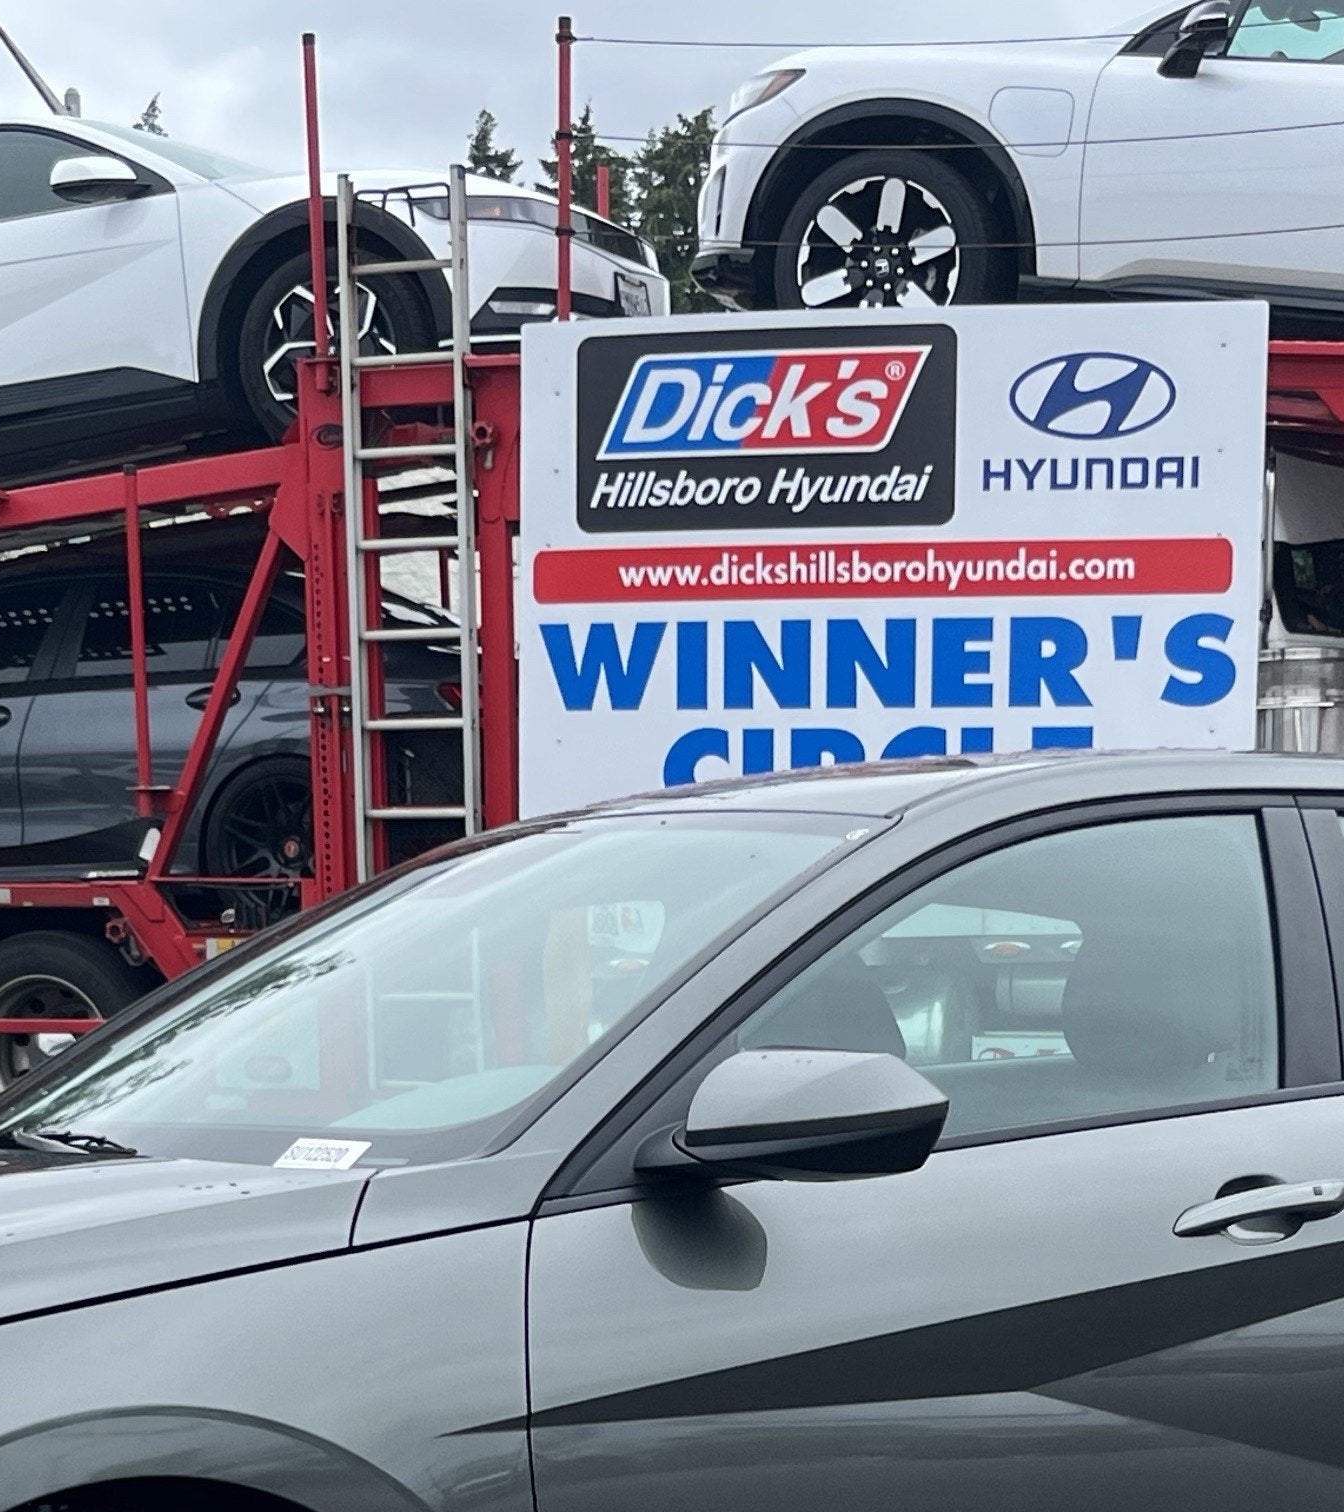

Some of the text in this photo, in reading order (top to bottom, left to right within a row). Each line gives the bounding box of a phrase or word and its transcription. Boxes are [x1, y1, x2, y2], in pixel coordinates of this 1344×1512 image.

[590, 464, 933, 513] Hillsboro Hyundai
[983, 456, 1200, 492] HYUNDAI
[619, 549, 1136, 592] www.dickshillsborohyundai.com
[538, 612, 1237, 711] WINNER'S
